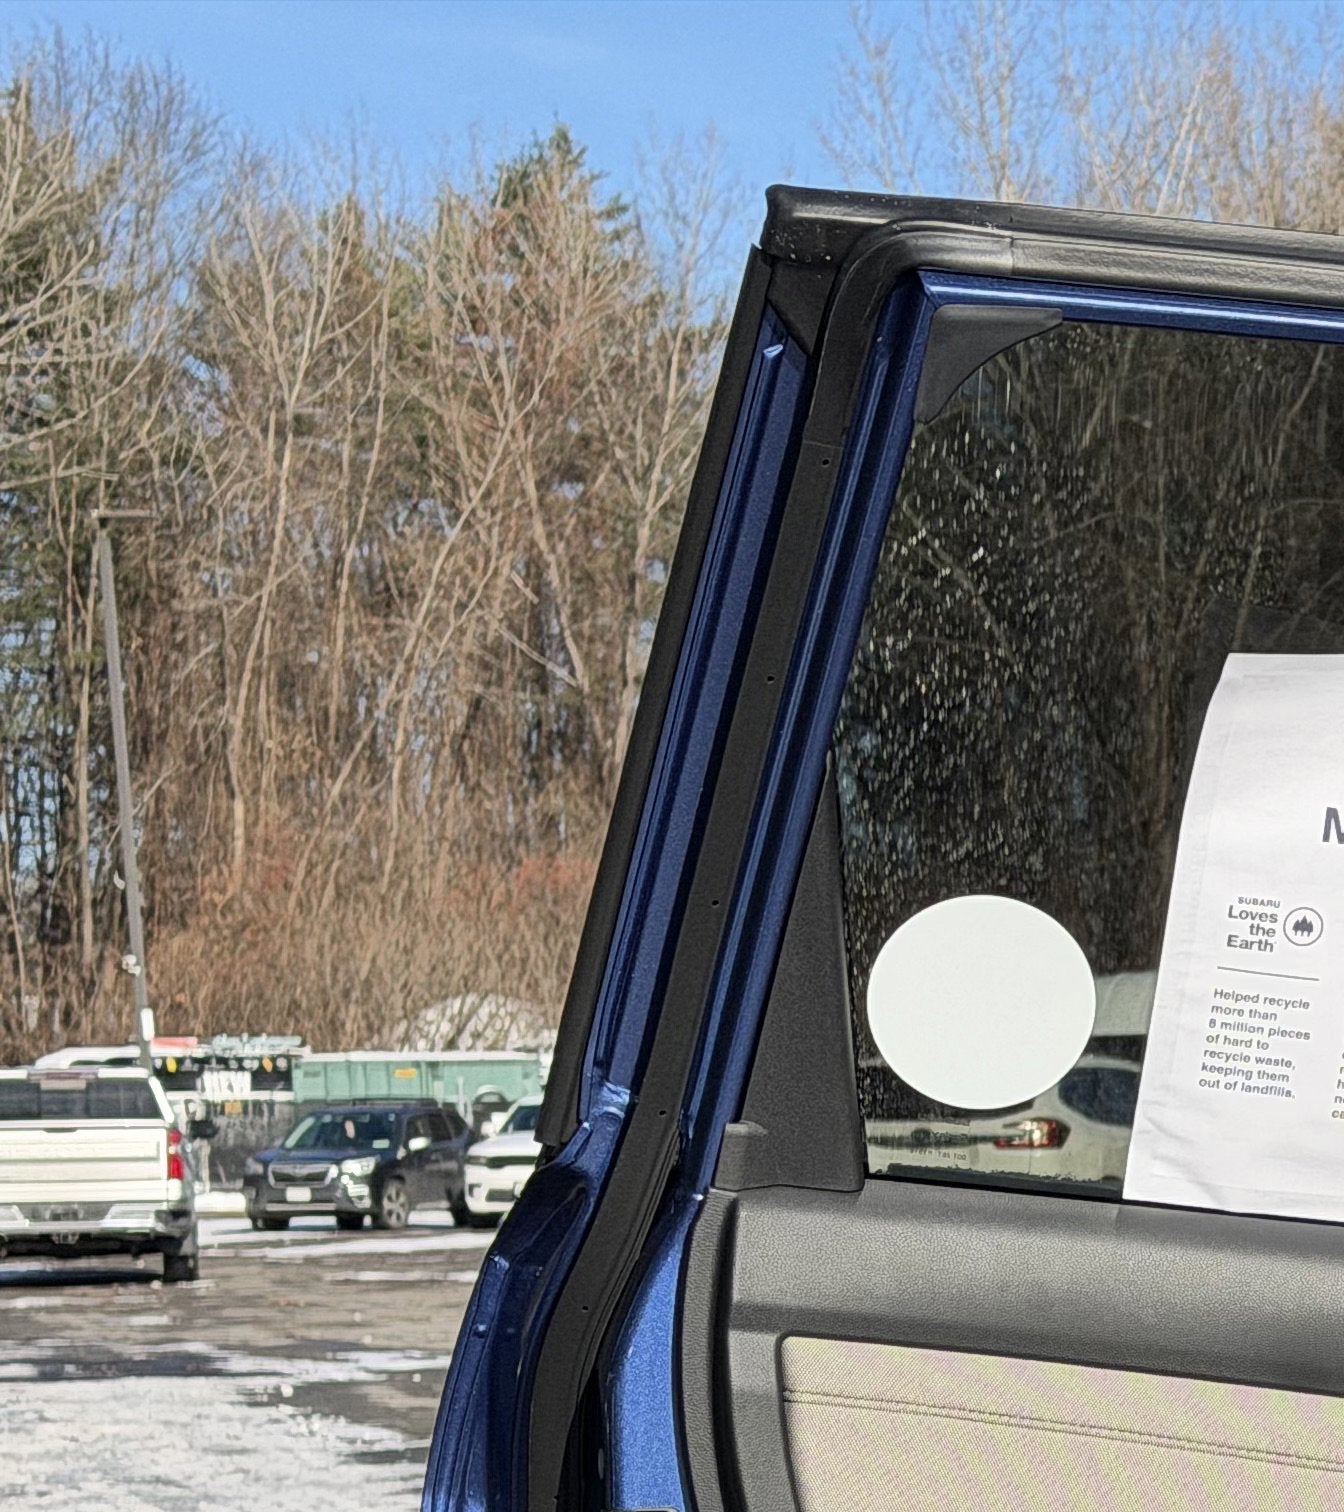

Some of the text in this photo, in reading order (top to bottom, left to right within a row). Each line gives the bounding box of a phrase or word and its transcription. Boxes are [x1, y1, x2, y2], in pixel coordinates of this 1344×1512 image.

[1237, 896, 1281, 909] SUBARU
[1227, 904, 1278, 924] Loves
[1248, 922, 1276, 938] the
[1226, 933, 1274, 953] Earth
[1213, 987, 1310, 1010] Helped recycle
[1210, 1004, 1278, 1022] more than
[1208, 1017, 1311, 1041] 8 million pieces
[1205, 1033, 1270, 1051] of hard to
[1203, 1049, 1296, 1071] recycle waste,
[1200, 1061, 1290, 1083] keeping them
[1198, 1078, 1295, 1099] out of landfills.
